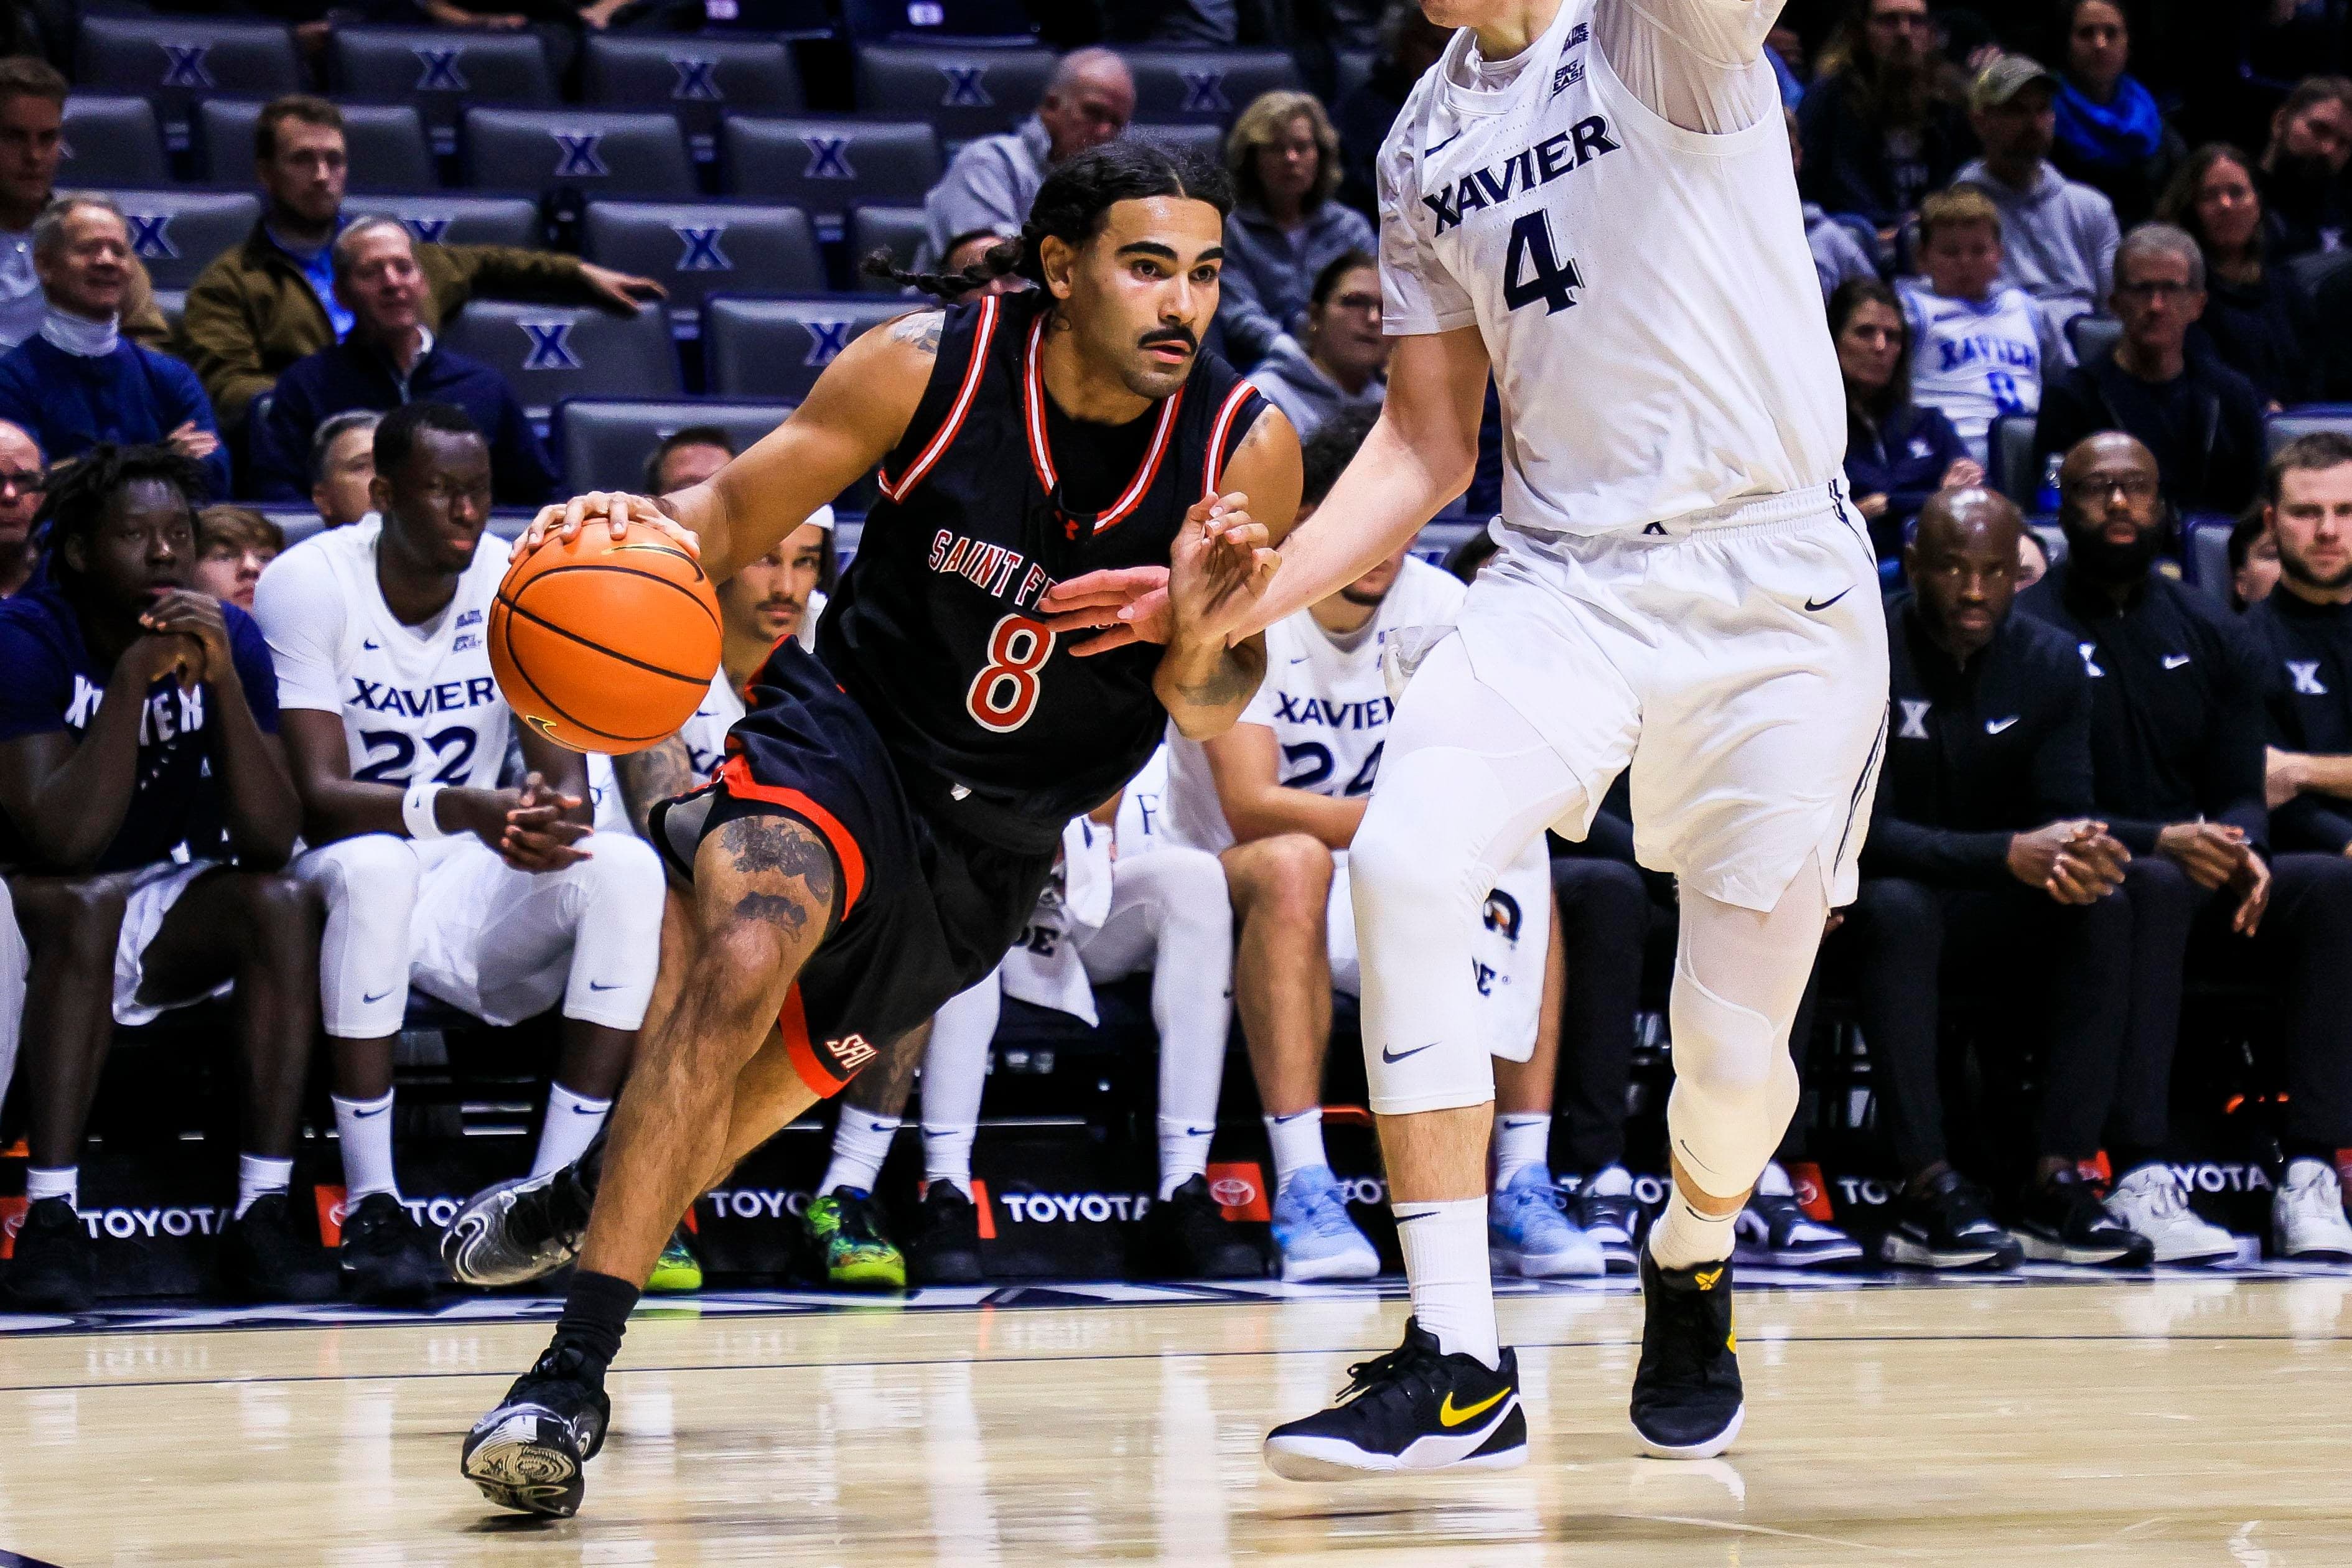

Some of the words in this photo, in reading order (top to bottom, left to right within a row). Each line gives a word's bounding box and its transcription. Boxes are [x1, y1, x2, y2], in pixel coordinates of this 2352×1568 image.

[1554, 58, 1579, 81] BIG
[1421, 114, 1621, 238] XAVIER
[1503, 207, 1586, 316] 4
[928, 529, 1024, 597] SAINT
[346, 676, 497, 718] XAVER
[966, 613, 1057, 733] 8
[1898, 699, 1931, 739] X
[352, 726, 478, 789] 22
